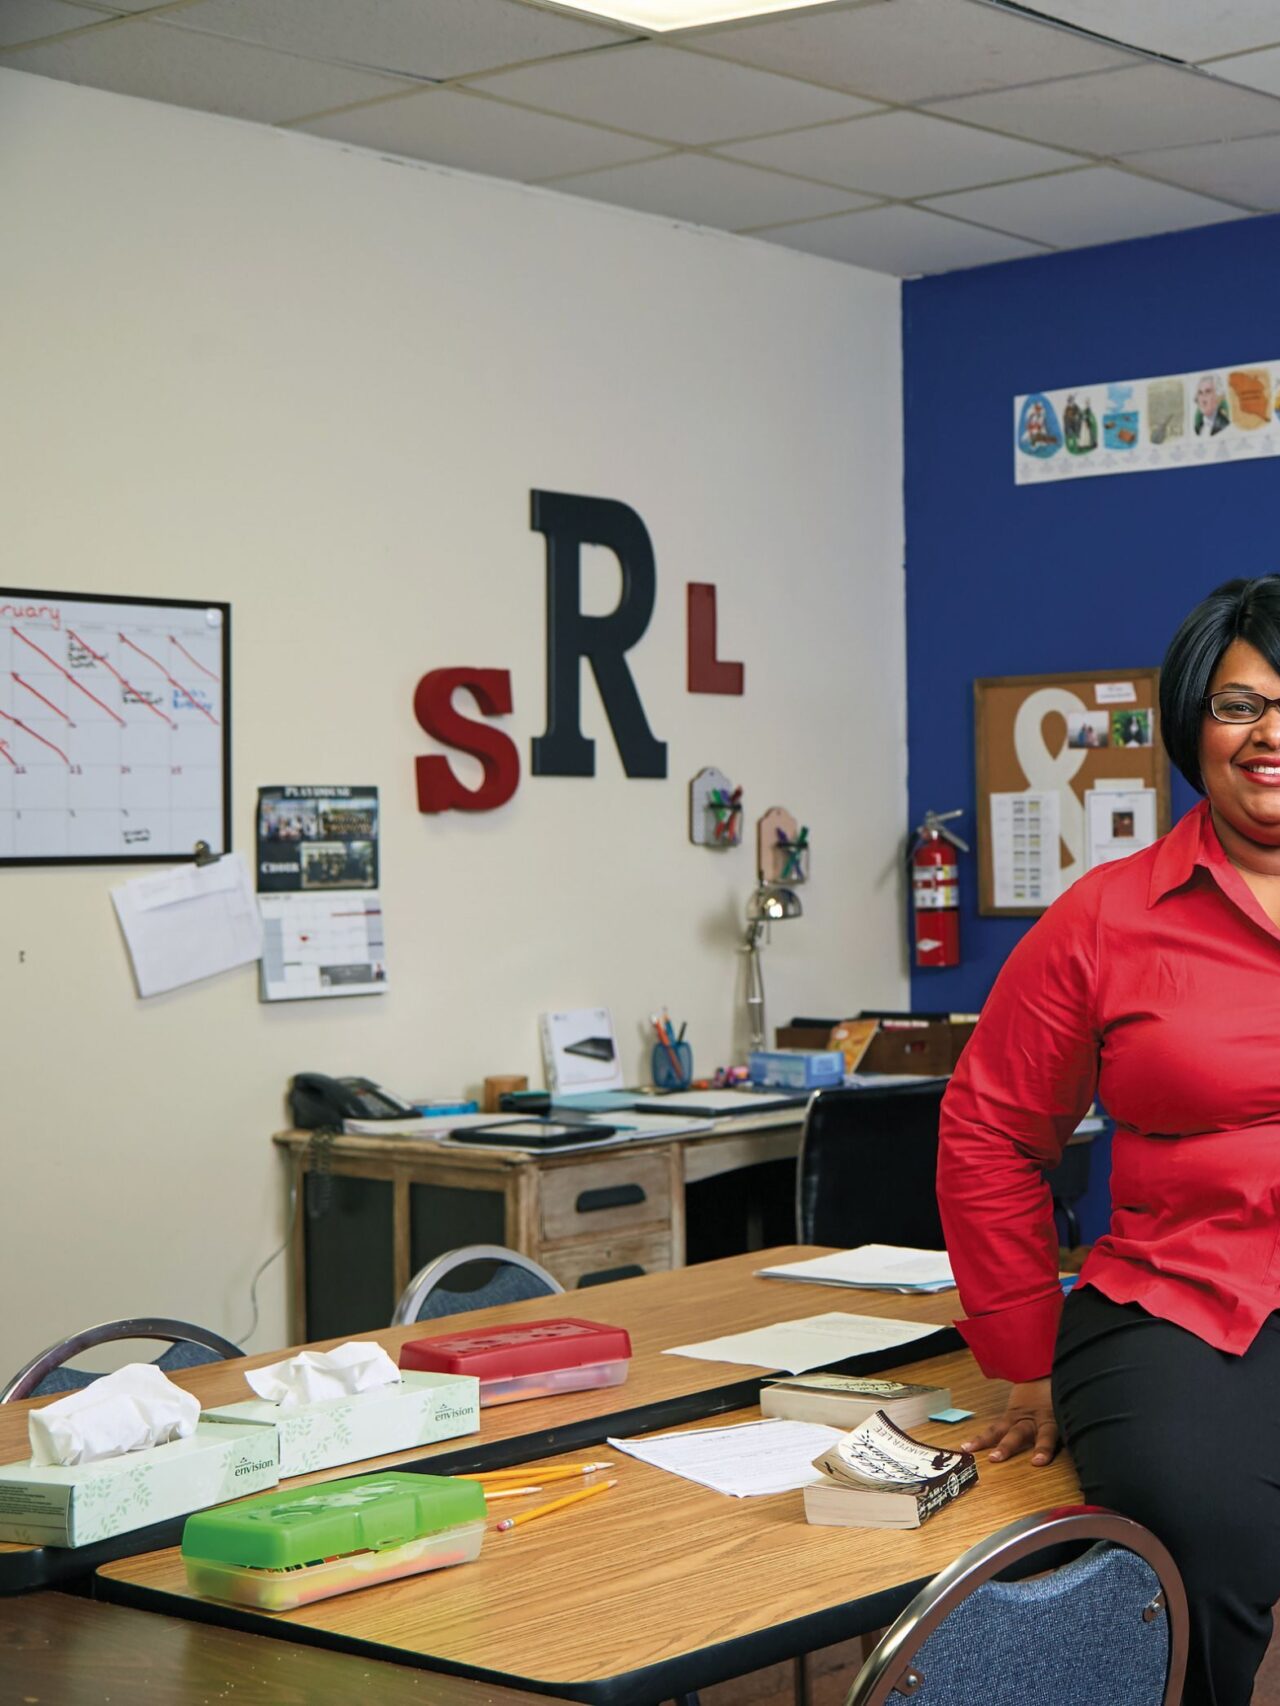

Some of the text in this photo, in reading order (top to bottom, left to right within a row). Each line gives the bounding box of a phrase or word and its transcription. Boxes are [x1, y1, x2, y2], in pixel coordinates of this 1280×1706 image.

[413, 488, 744, 814] S R L
[434, 1406, 474, 1422] envision
[234, 1459, 274, 1477] envision
